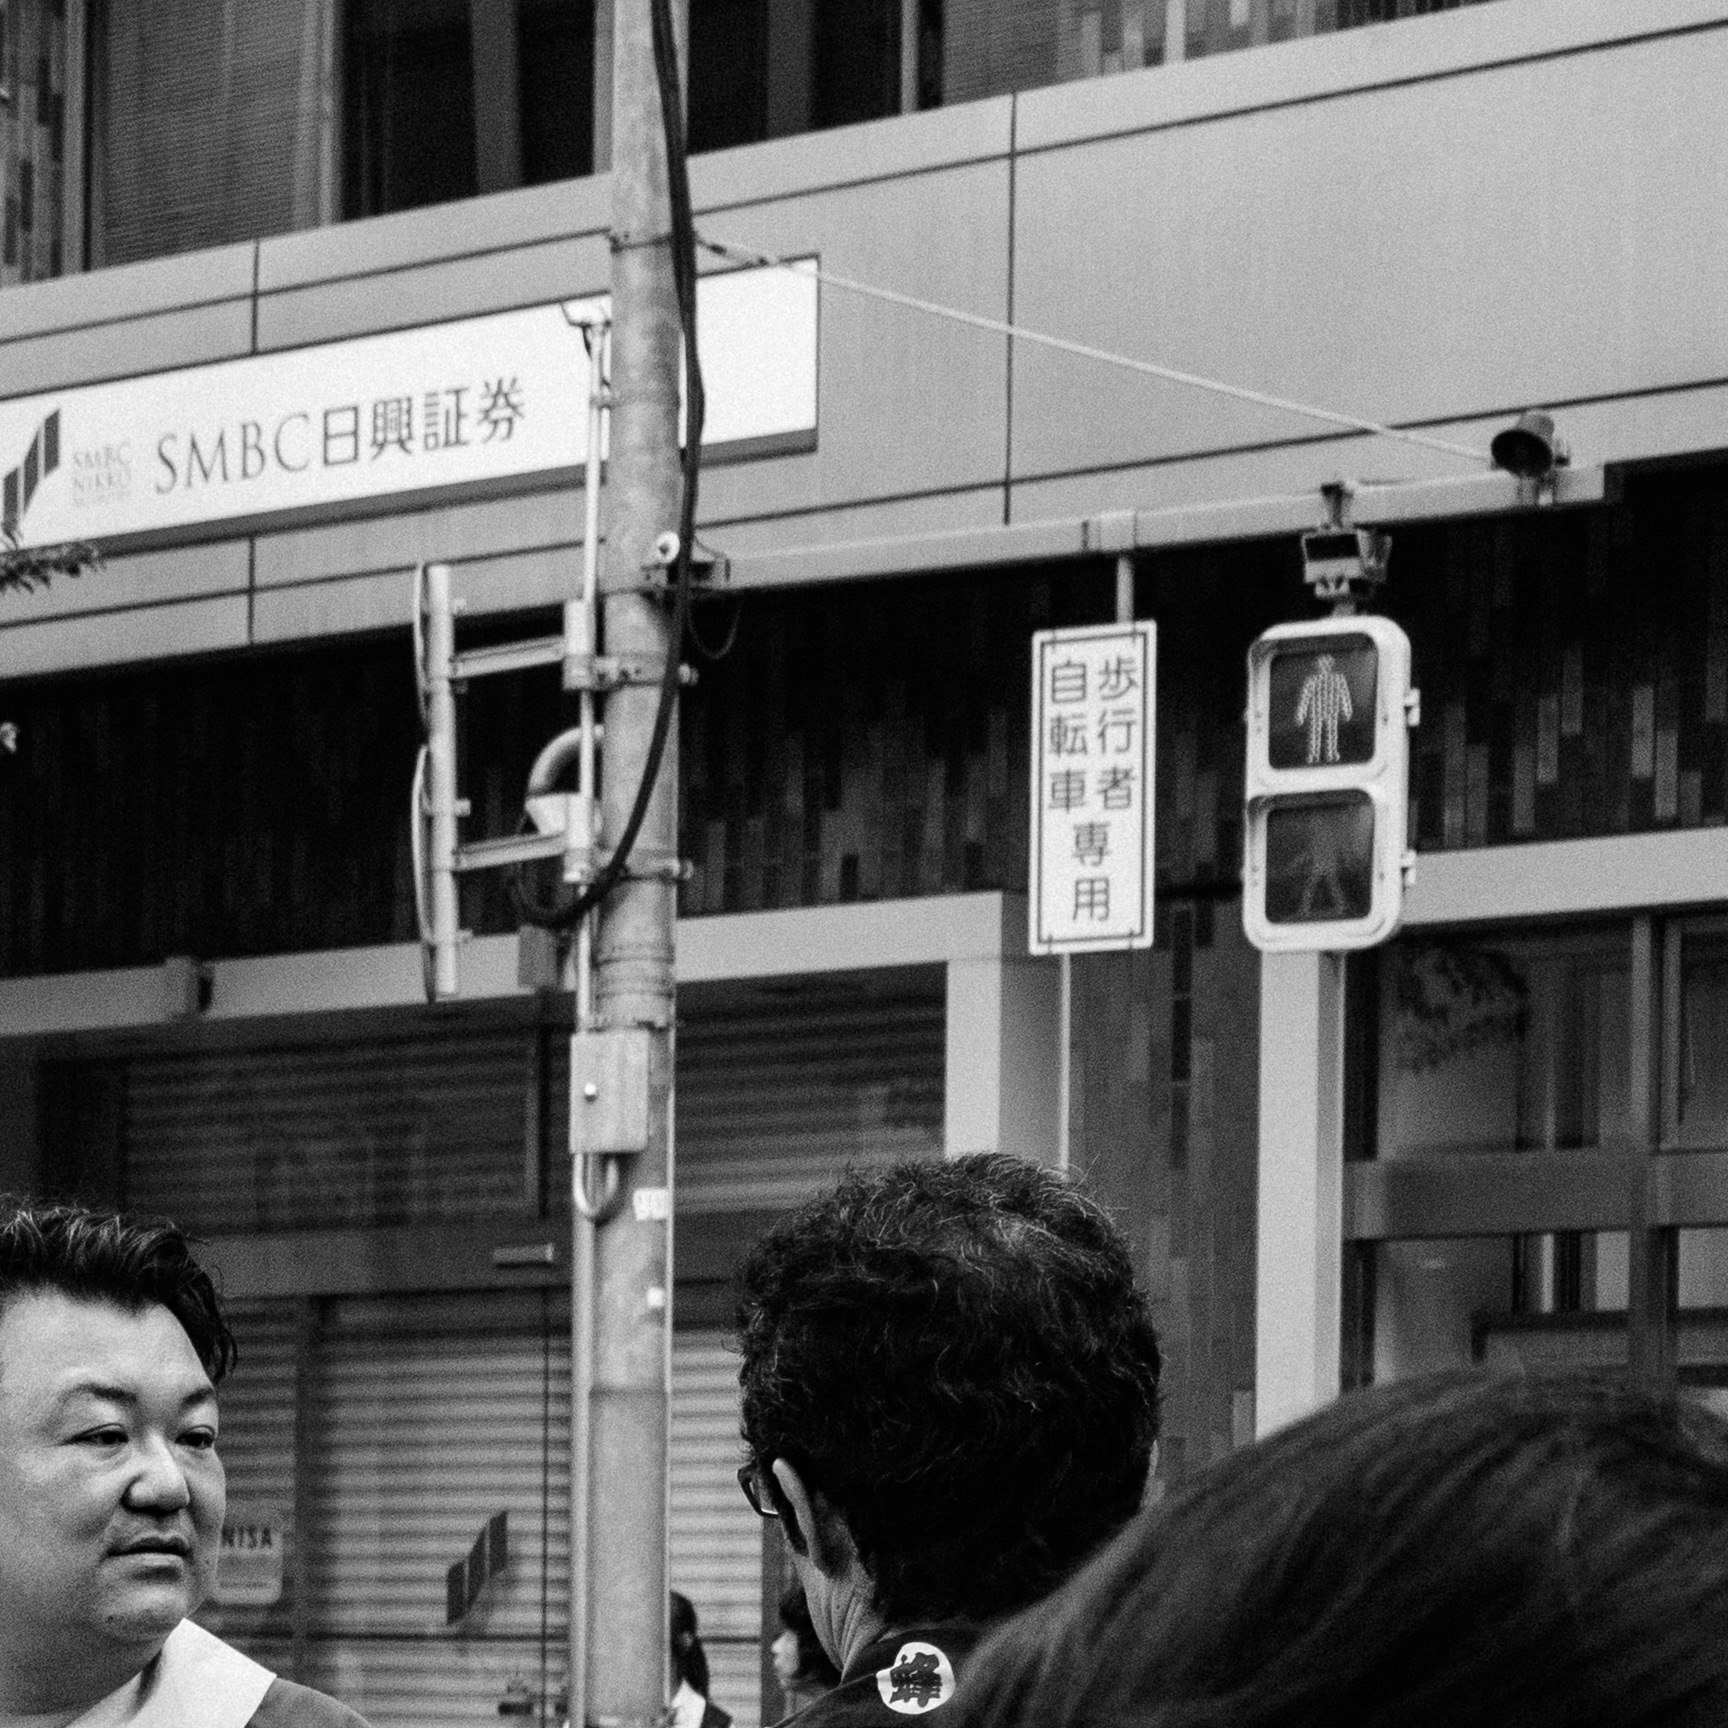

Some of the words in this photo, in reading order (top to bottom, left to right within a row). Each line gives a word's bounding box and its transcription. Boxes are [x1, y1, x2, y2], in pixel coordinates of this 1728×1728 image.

[153, 375, 527, 497] SMBC日興証券
[1048, 659, 1090, 814] 自転車
[1096, 656, 1139, 812] 歩行者
[1071, 819, 1111, 923] 専用
[221, 1524, 274, 1550] NISA
